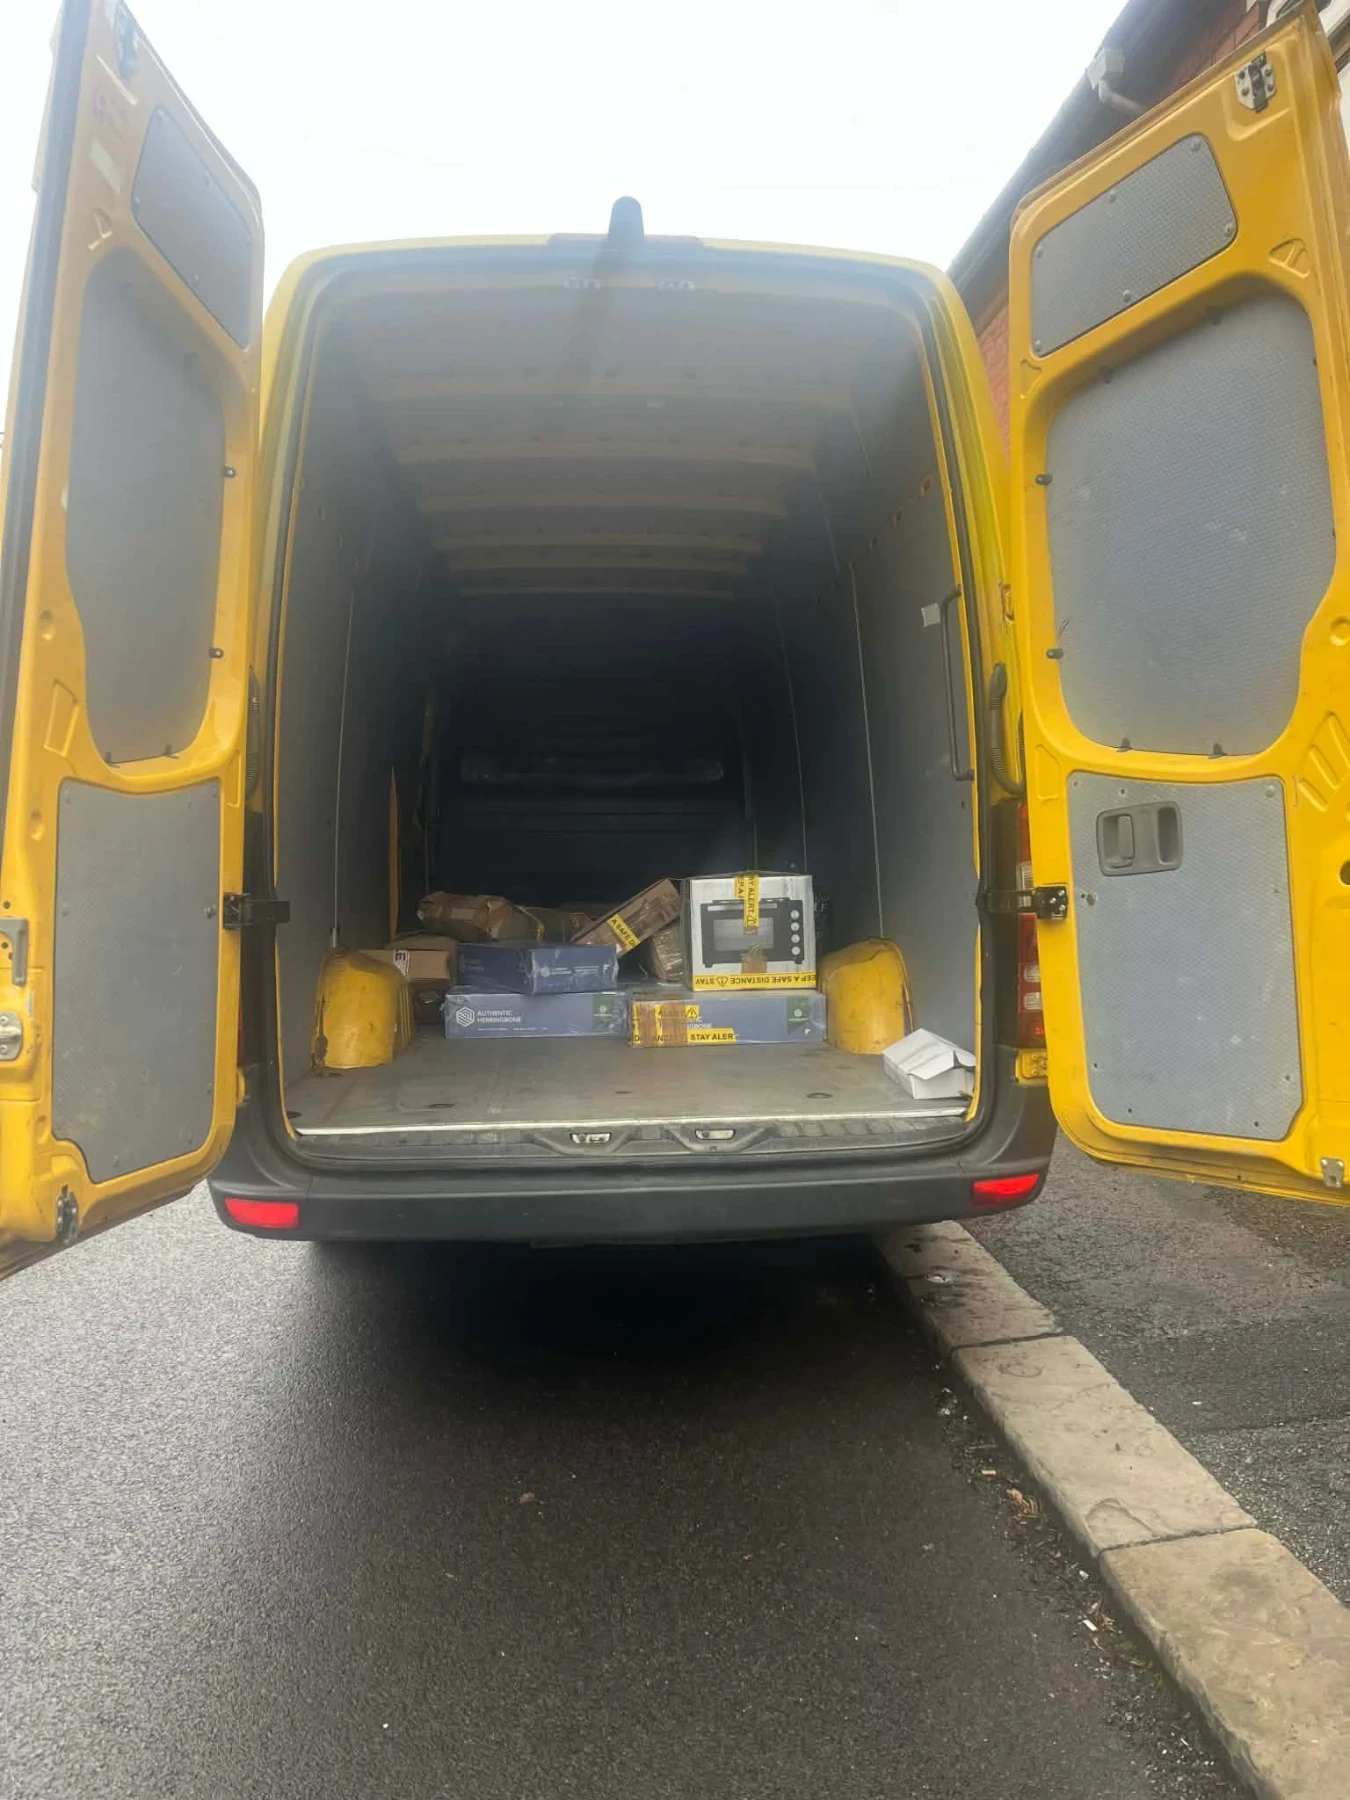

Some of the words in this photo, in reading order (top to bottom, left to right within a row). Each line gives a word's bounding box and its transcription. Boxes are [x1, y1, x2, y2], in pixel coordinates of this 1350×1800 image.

[695, 977, 715, 985] STAY
[730, 976, 770, 984] DISTANCE
[800, 974, 816, 982] EEP
[690, 1033, 710, 1041] STAY
